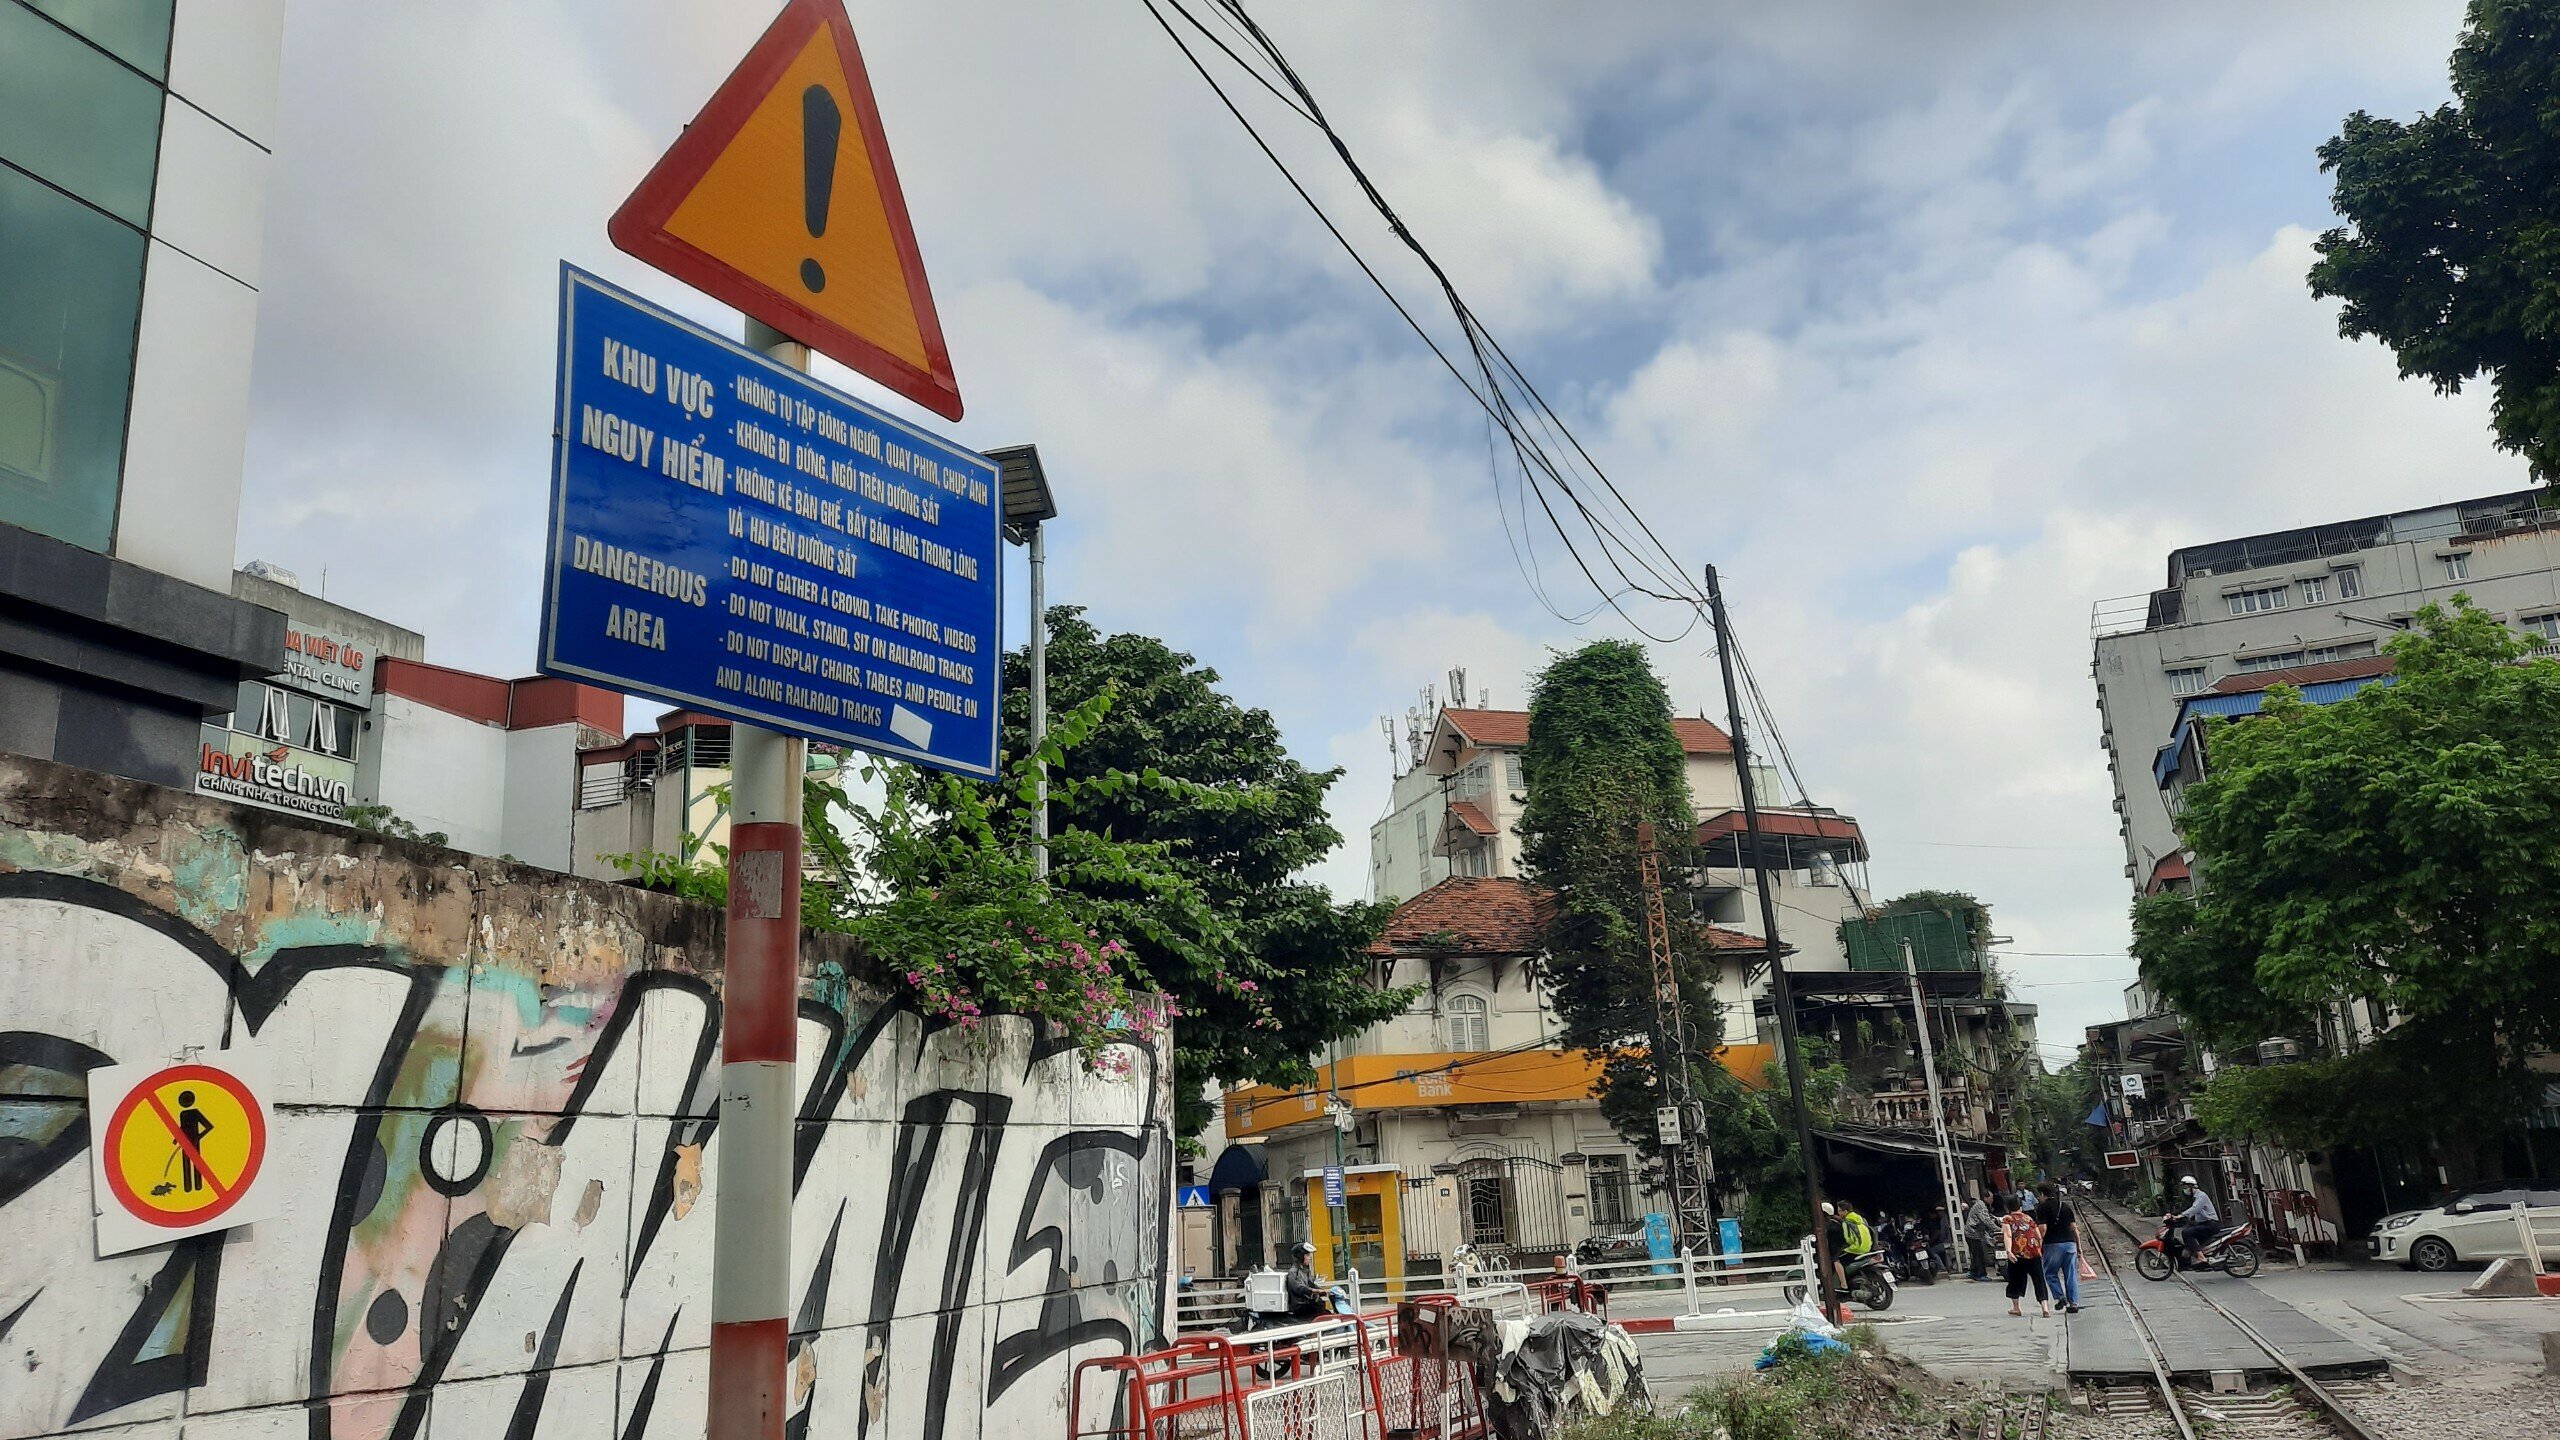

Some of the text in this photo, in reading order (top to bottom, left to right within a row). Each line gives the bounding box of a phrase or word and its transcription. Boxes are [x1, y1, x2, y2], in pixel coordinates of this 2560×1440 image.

[603, 336, 714, 421] KHU VỰC
[581, 404, 724, 496] NGUY HIỂM
[737, 374, 776, 415] KHÔNG
[779, 393, 792, 427] TỤ
[795, 399, 815, 434] TẬP
[818, 410, 847, 446] ĐÔNG
[886, 441, 911, 473] QUAY
[913, 453, 941, 489] PHIM,
[943, 467, 967, 500] CHỤP
[969, 469, 988, 506] ẢNH
[737, 419, 776, 460] KHÔNG
[778, 437, 790, 465] ĐI
[859, 471, 885, 504] TRÊN
[887, 483, 920, 518] ĐƯỜNG
[921, 493, 940, 526] SẮT
[735, 465, 775, 505] KHÔNG
[778, 481, 792, 512] KÊ
[795, 486, 818, 521] BÀN
[869, 517, 891, 549] BÁN
[892, 524, 919, 559] HÀNG
[920, 538, 952, 572] TRONG
[953, 548, 978, 581] LÒNG
[750, 516, 769, 547] HAI
[772, 522, 795, 557] BÊN
[797, 533, 834, 571] ĐƯỜNG
[837, 543, 857, 579] SẮT
[573, 535, 707, 607] DANGEROUS
[731, 555, 977, 654] DO NOT GATHER A CROWD, TAKE PHOTOS, VIDEOS
[304, 634, 339, 665] VIỆT
[341, 643, 364, 671] ÚC
[605, 604, 666, 651] AREA
[729, 592, 974, 685] DO NOT WALK, STAND, SIT ON RAILROAD TRACKS
[321, 672, 361, 694] CLINIC
[715, 665, 882, 728] AND ALONG RAILROAD TRACKS
[727, 629, 978, 719] DO NOT DISPLAY CHAIRS, TABLES AND PEDDLE ON
[202, 742, 349, 803] Invitech.vn
[245, 786, 271, 800] NHA
[275, 793, 316, 812] TRONG
[1418, 1084, 1452, 1097] Bank
